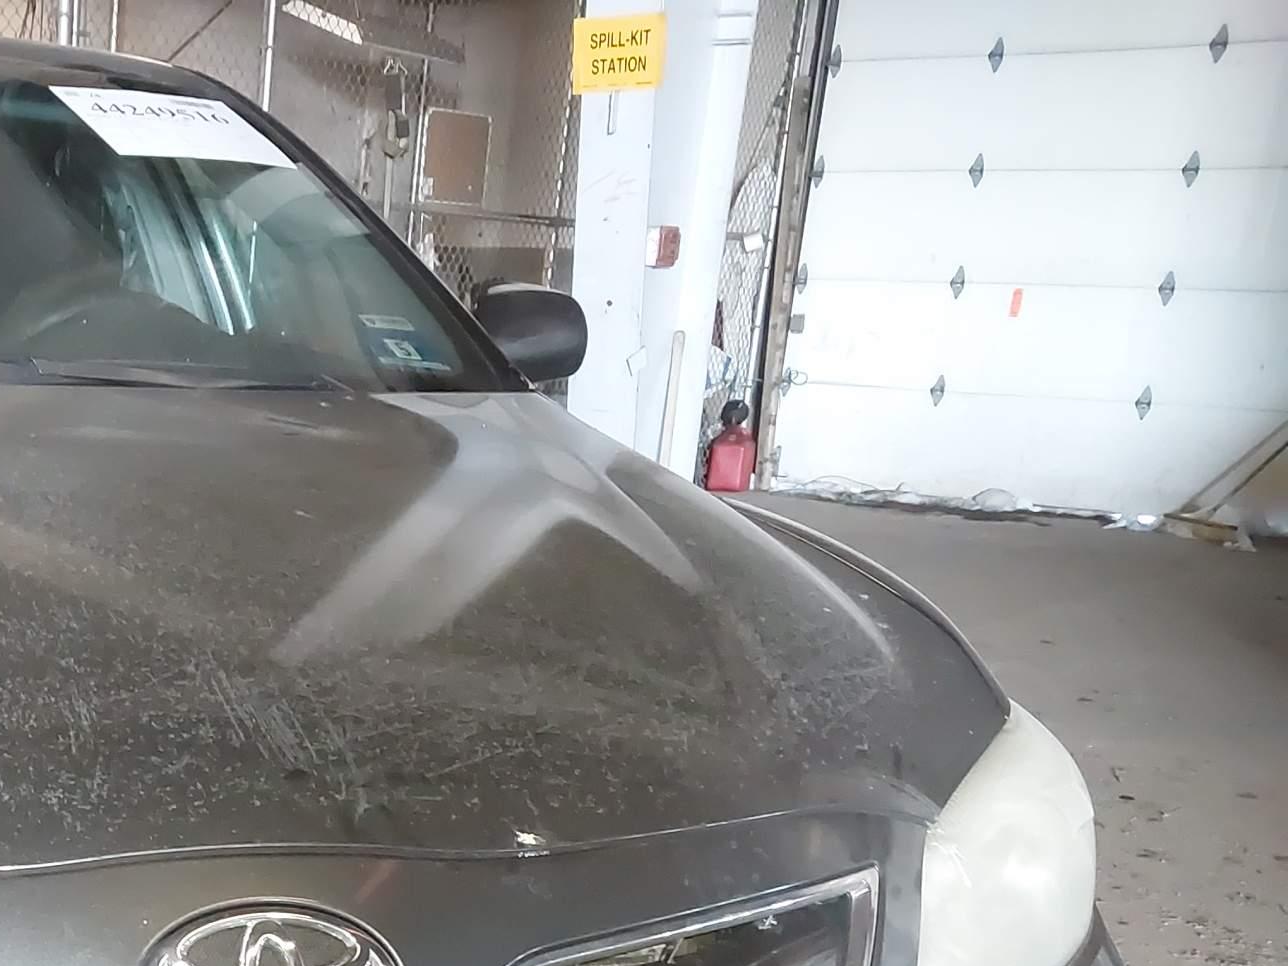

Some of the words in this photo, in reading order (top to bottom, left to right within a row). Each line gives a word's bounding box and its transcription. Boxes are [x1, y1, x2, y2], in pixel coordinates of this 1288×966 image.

[590, 29, 651, 49] SPILL-KIT
[591, 56, 647, 75] STATION
[91, 102, 229, 124] 44249516
